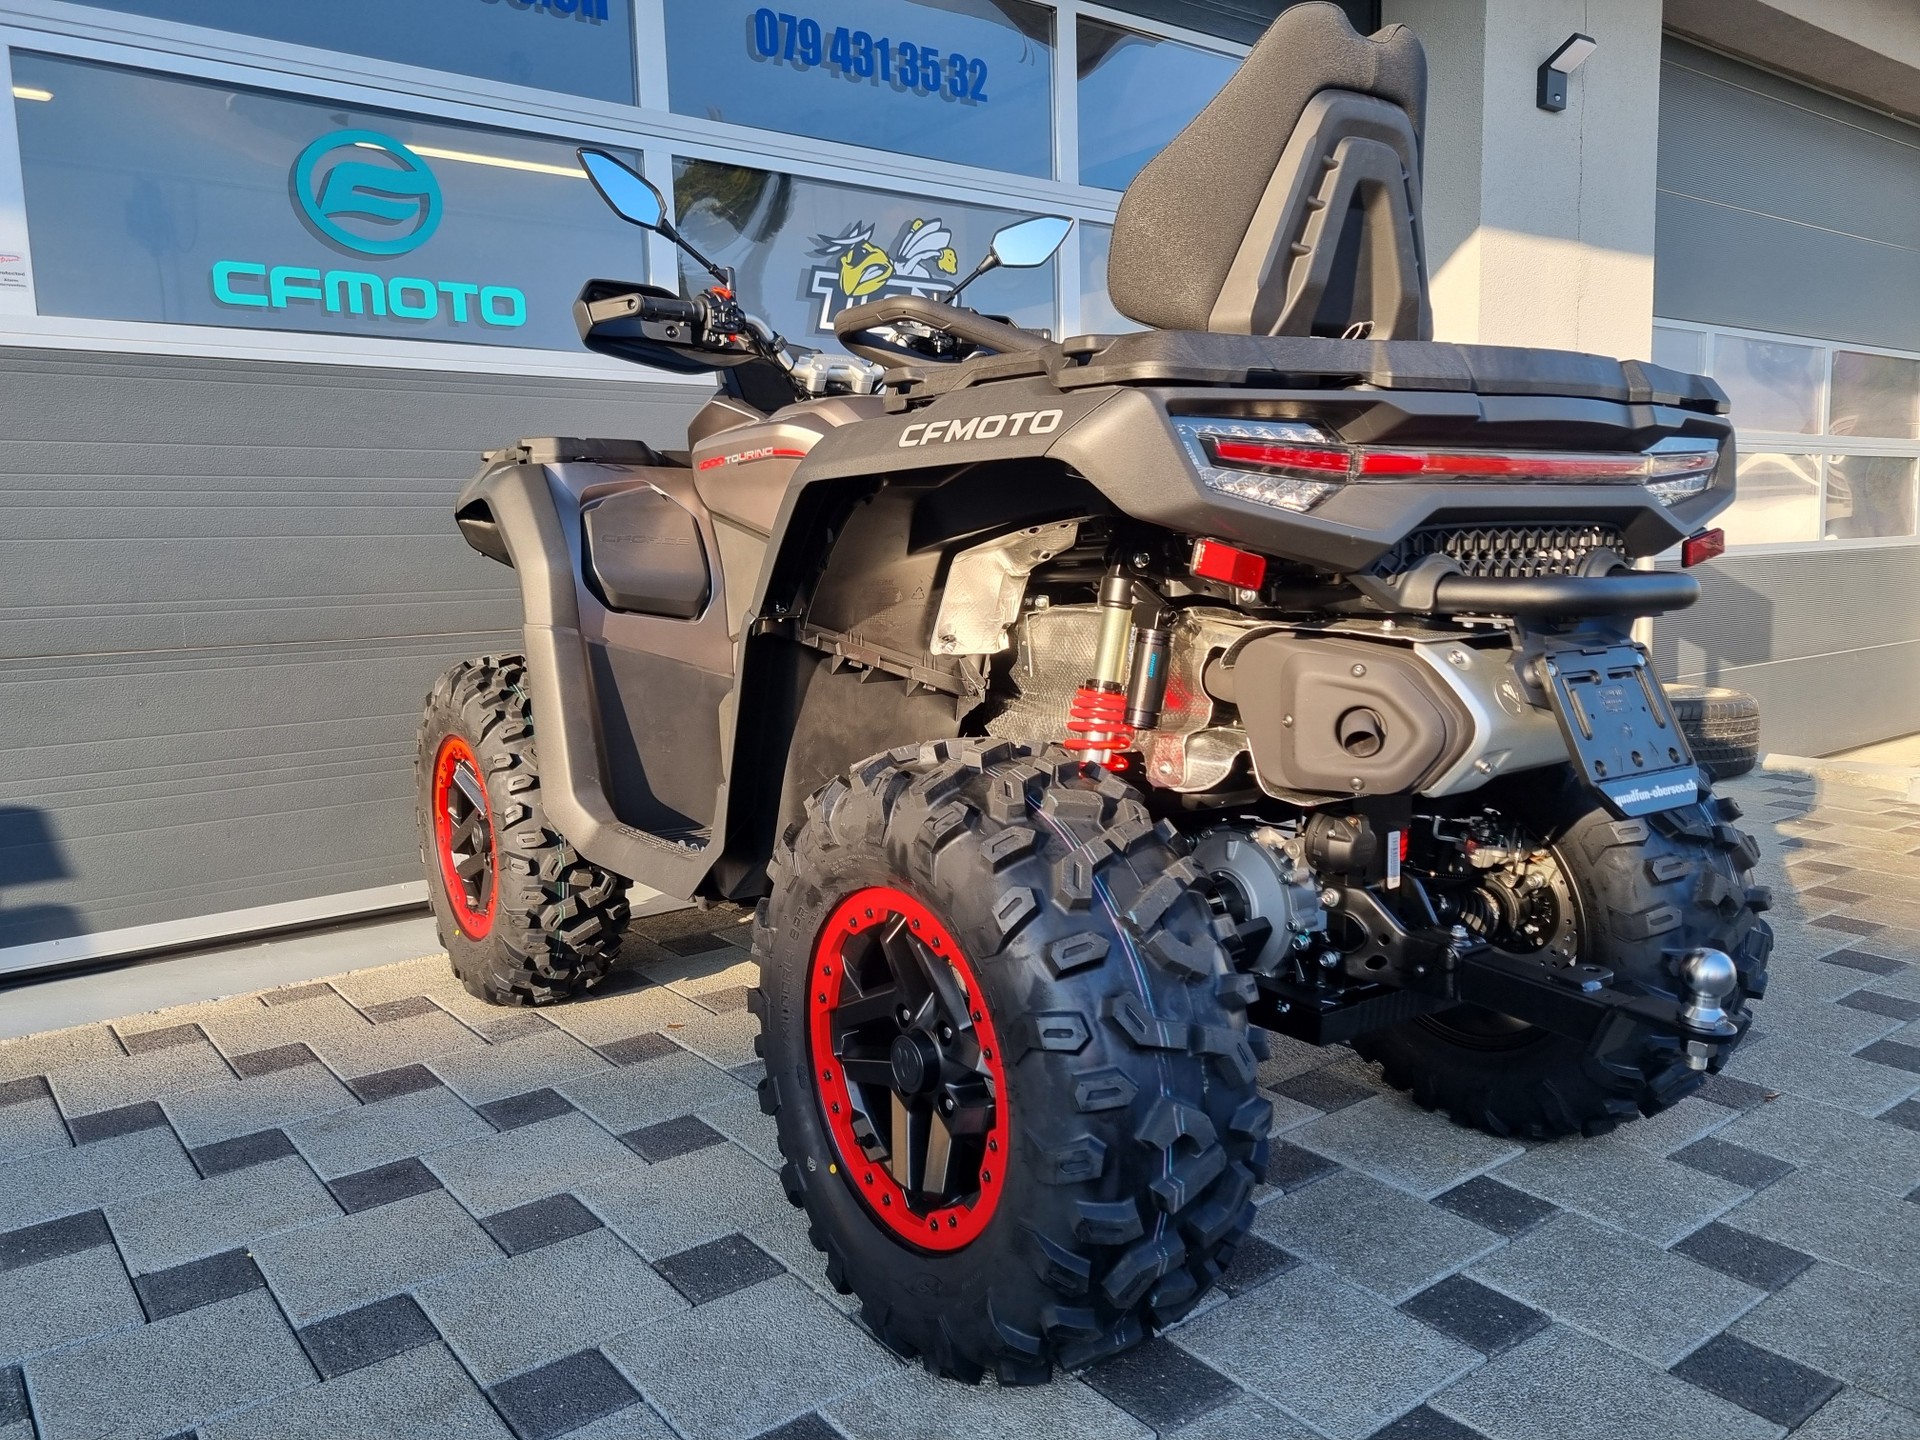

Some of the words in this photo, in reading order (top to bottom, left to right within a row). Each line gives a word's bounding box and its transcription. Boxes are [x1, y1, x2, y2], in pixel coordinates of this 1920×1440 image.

[755, 7, 822, 67] 079
[829, 26, 891, 82] 431
[898, 41, 942, 92] 35
[949, 53, 989, 103] 32
[212, 260, 527, 327] CFMOTO
[898, 408, 1064, 449] CFMOTO
[724, 446, 774, 465] TOURING
[1613, 779, 1697, 807] quadfun-obersee.ch
